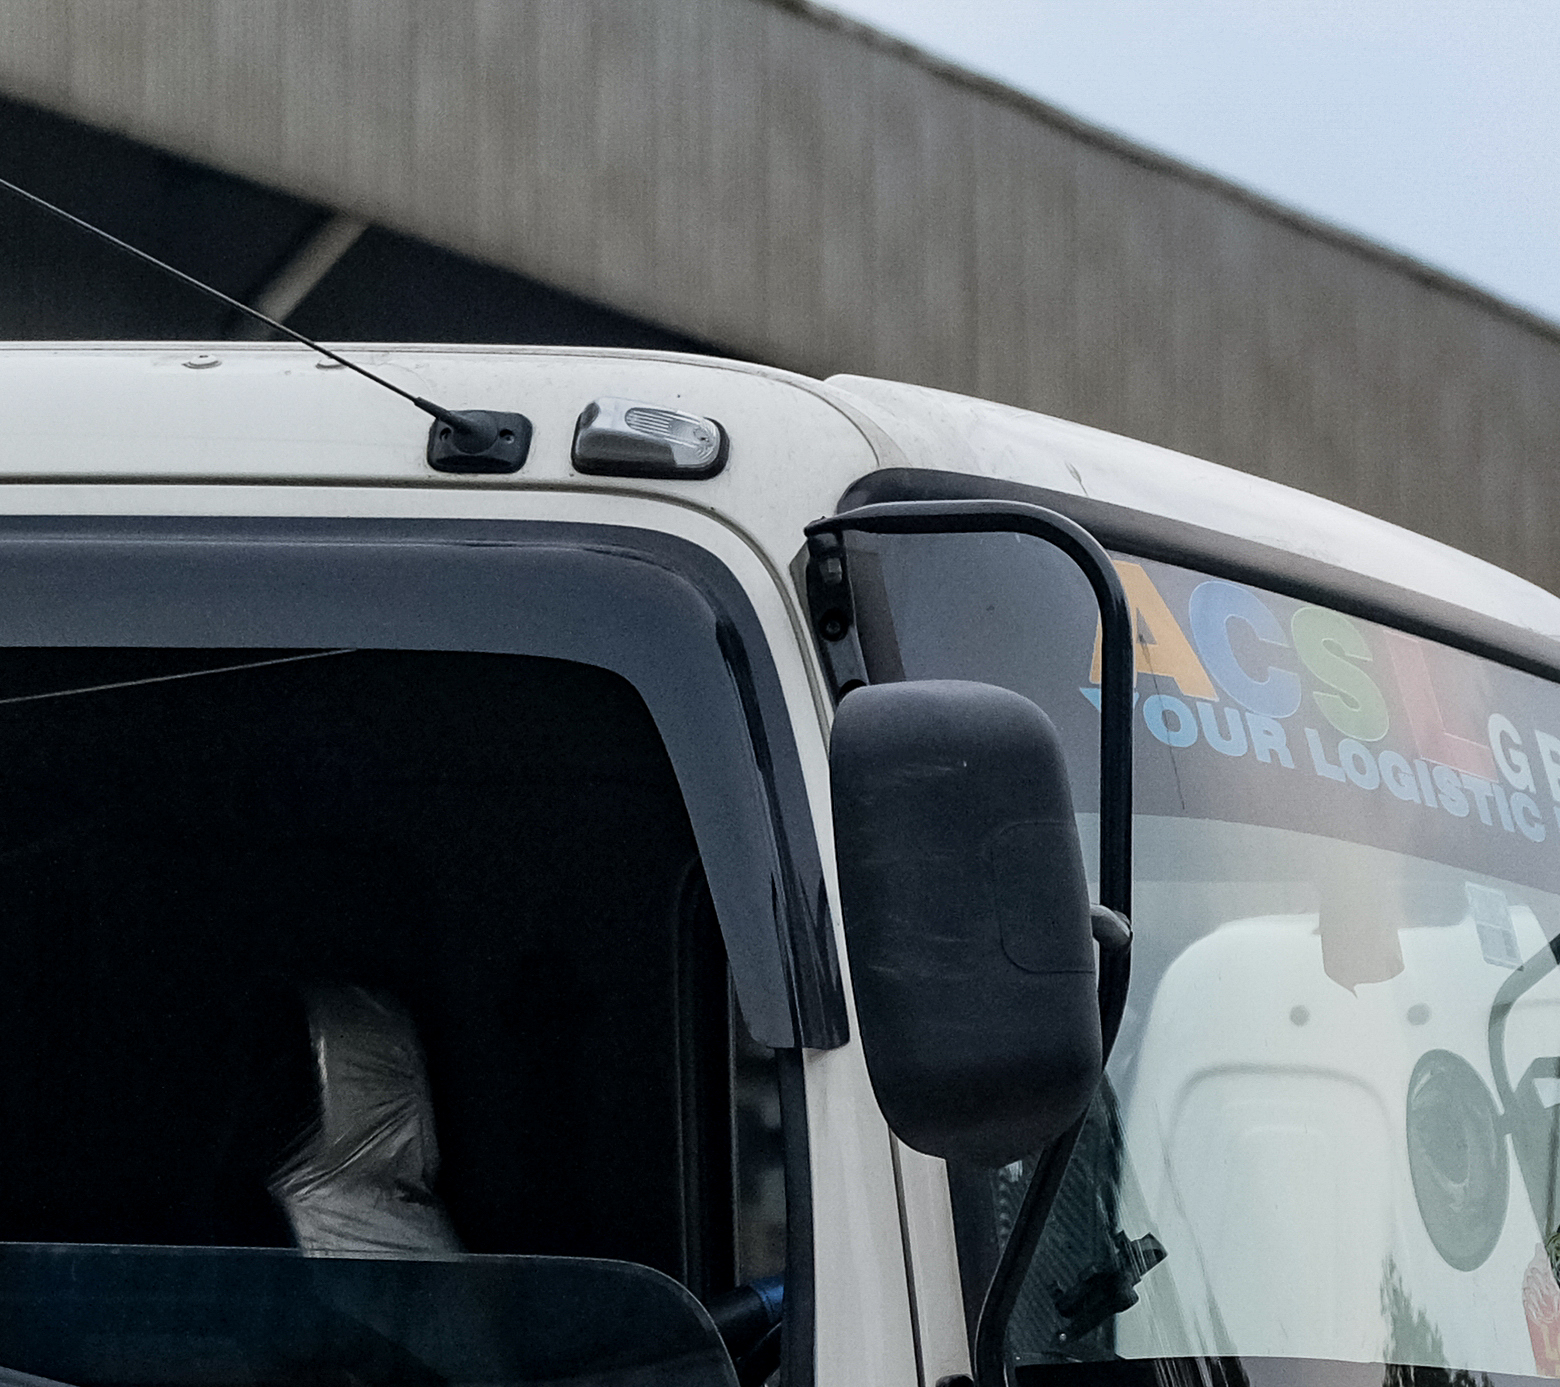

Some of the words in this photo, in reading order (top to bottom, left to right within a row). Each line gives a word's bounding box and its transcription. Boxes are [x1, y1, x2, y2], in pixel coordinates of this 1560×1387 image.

[1080, 687, 1295, 768] OUR
[1306, 728, 1546, 842] LOGISTIC
[1088, 559, 1498, 782] ACSL
